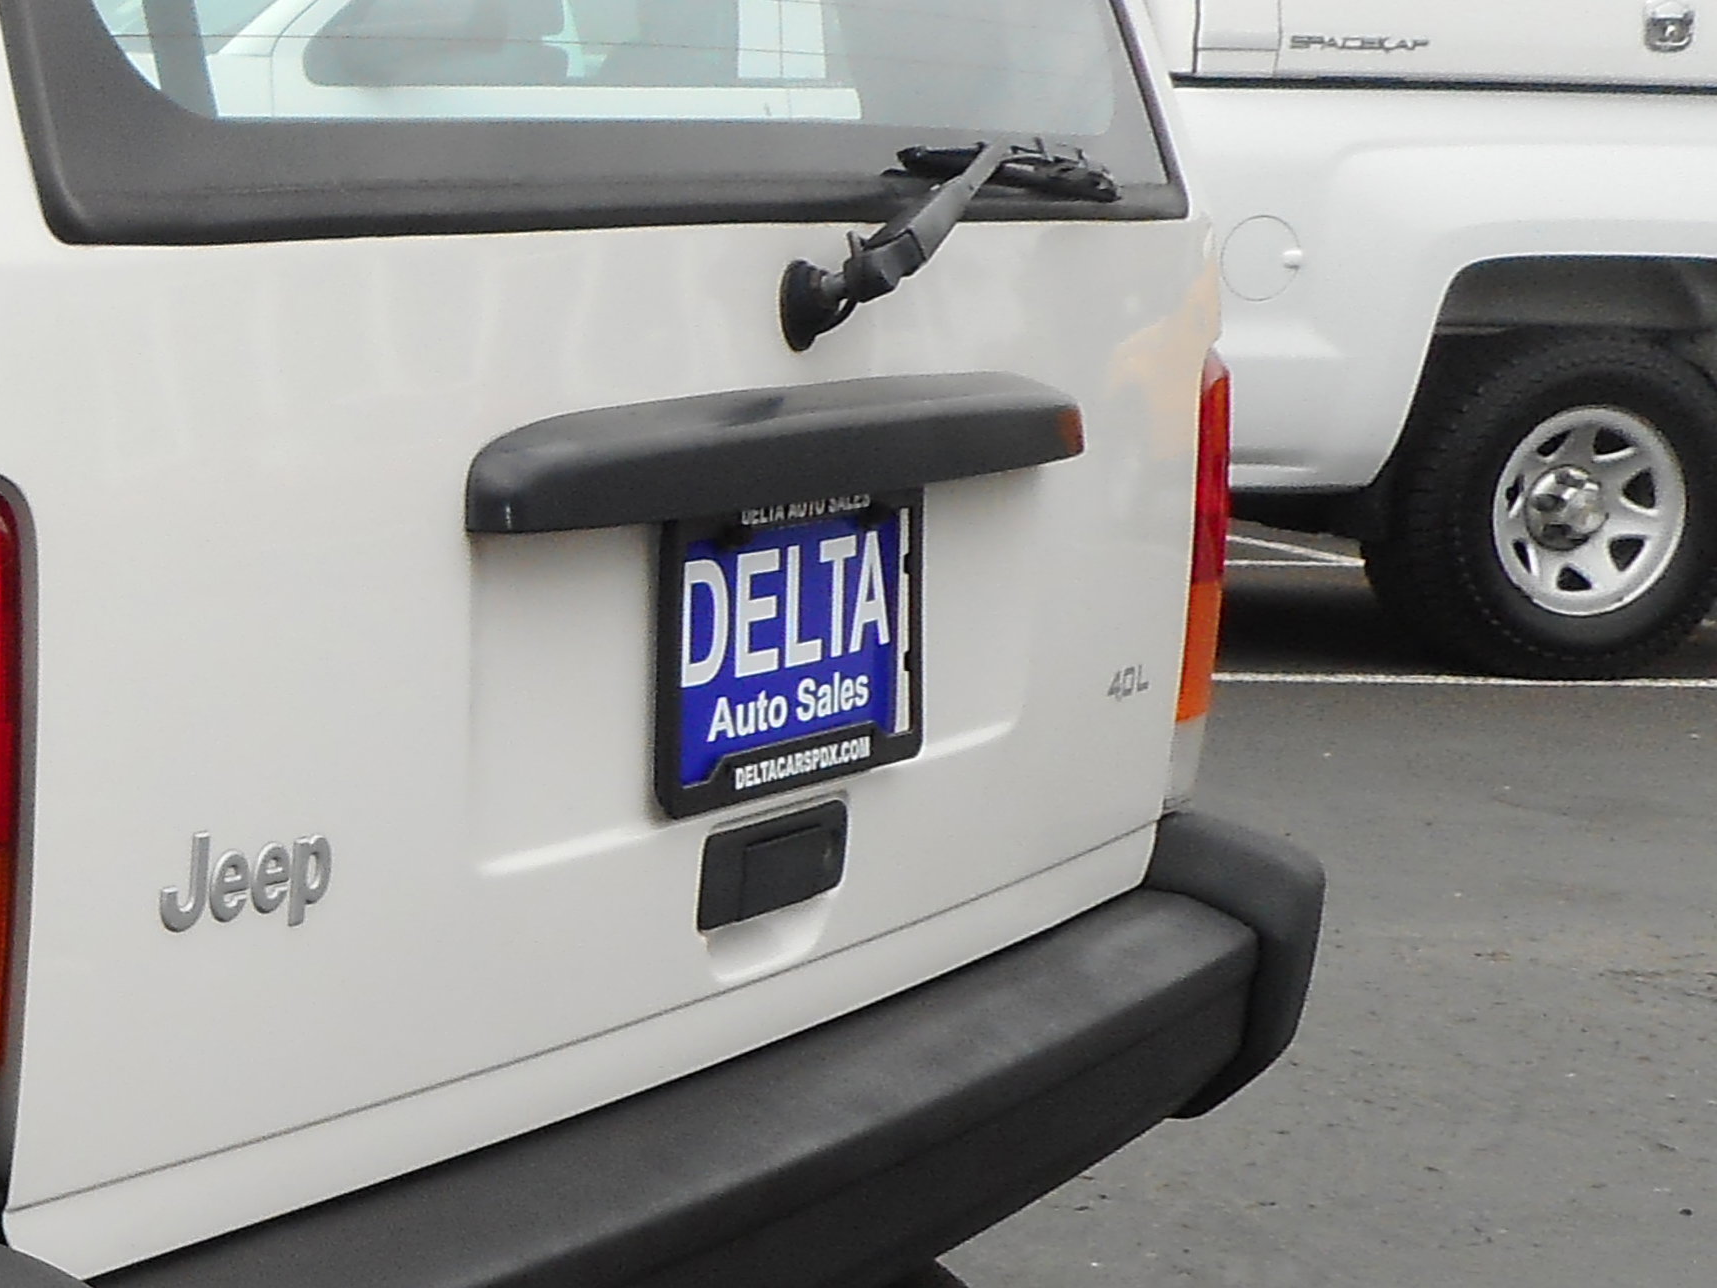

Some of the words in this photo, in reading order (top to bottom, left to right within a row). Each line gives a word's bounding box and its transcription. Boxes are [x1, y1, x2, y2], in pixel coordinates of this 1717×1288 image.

[680, 530, 890, 688] DELTA
[707, 690, 788, 743] Auto
[796, 671, 870, 720] Sales
[734, 735, 871, 791] DELTACARSPDX.COM
[160, 830, 332, 933] Jeep
